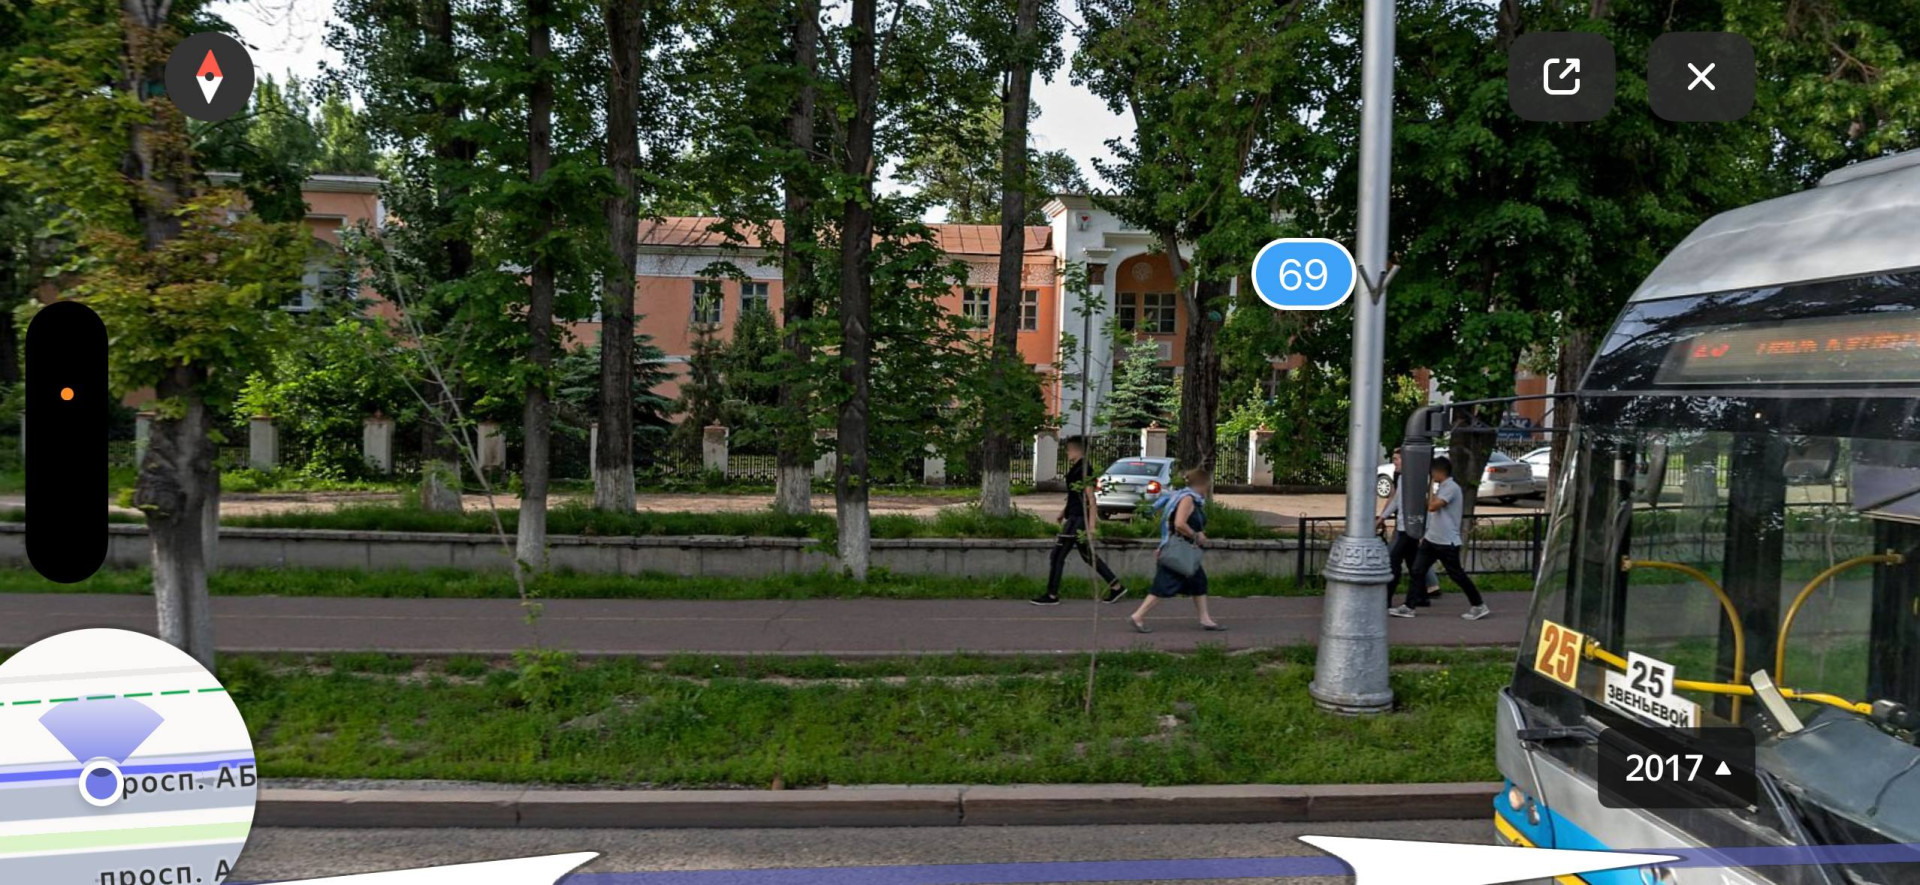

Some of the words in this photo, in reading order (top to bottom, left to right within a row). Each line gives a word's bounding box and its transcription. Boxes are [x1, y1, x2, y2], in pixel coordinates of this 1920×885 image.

[1539, 625, 1577, 683] 25
[1631, 661, 1665, 698] 25
[1608, 684, 1689, 729] ЗВЕНЬЕВОЙ
